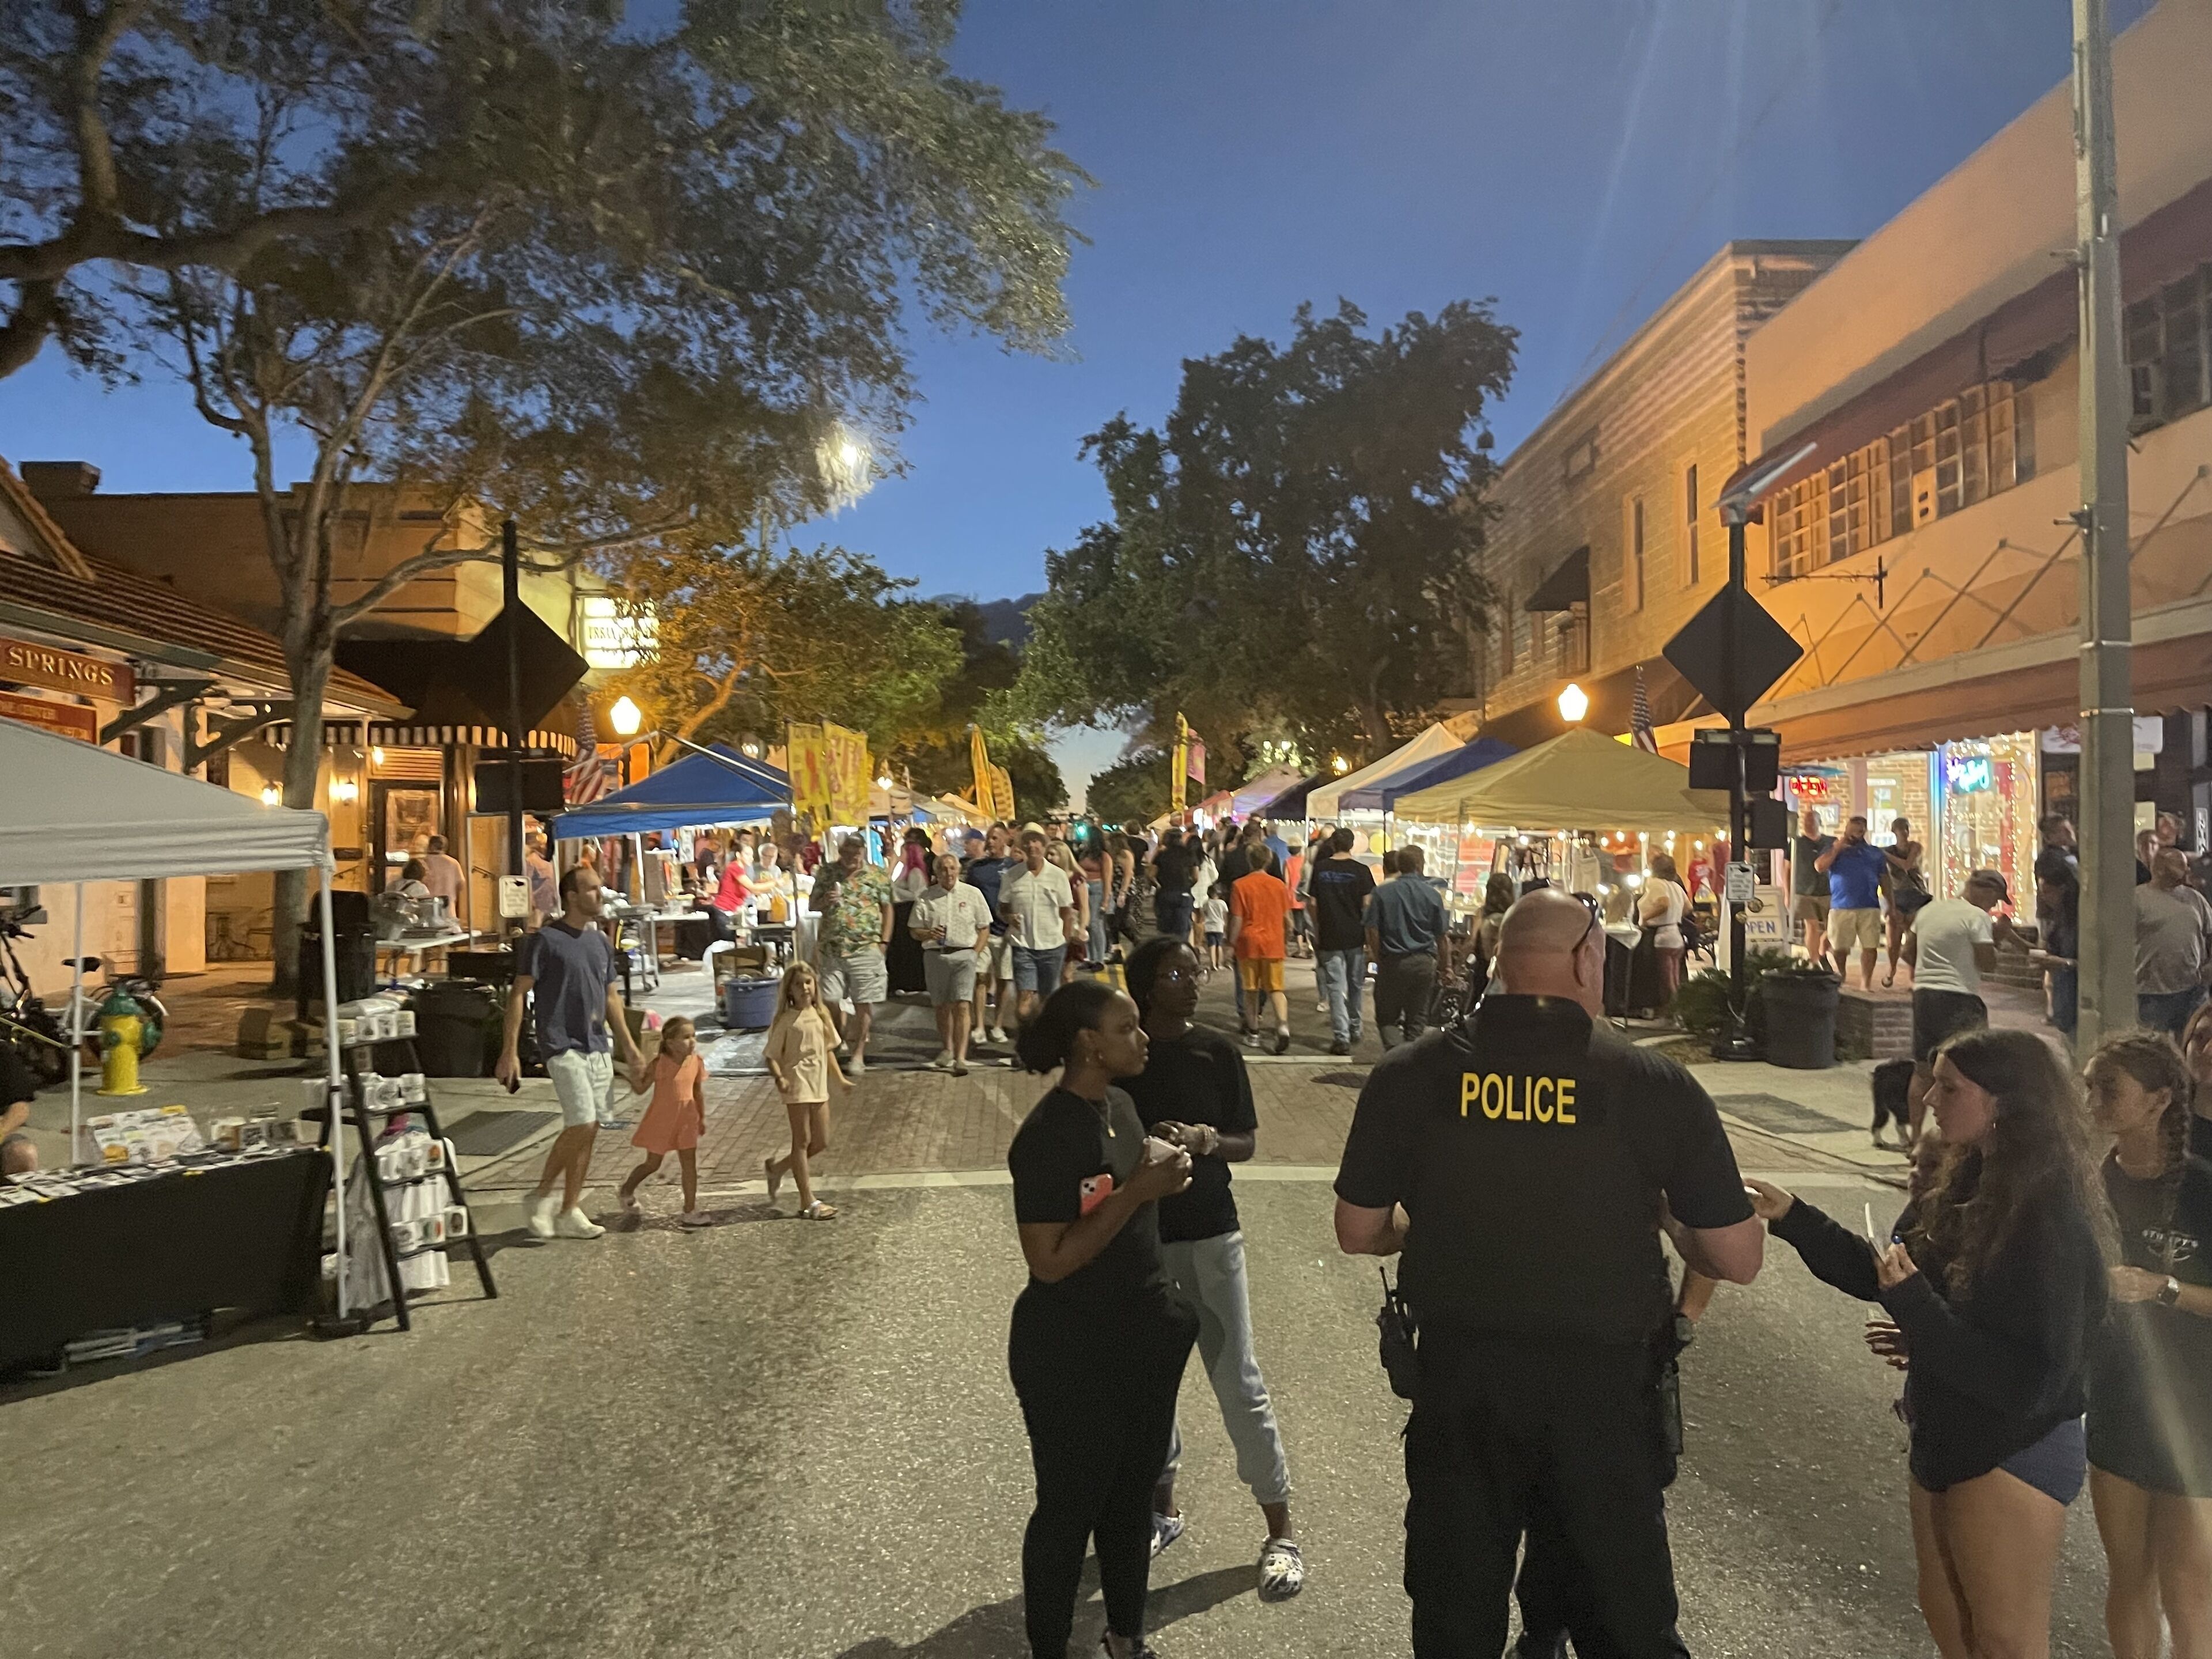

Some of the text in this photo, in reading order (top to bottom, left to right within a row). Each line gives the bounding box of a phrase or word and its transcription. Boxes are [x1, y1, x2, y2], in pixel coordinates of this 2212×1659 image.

[9, 646, 115, 685] SPRINGS
[1790, 776, 1828, 796] OPEN
[1461, 1072, 1576, 1124] POLICE
